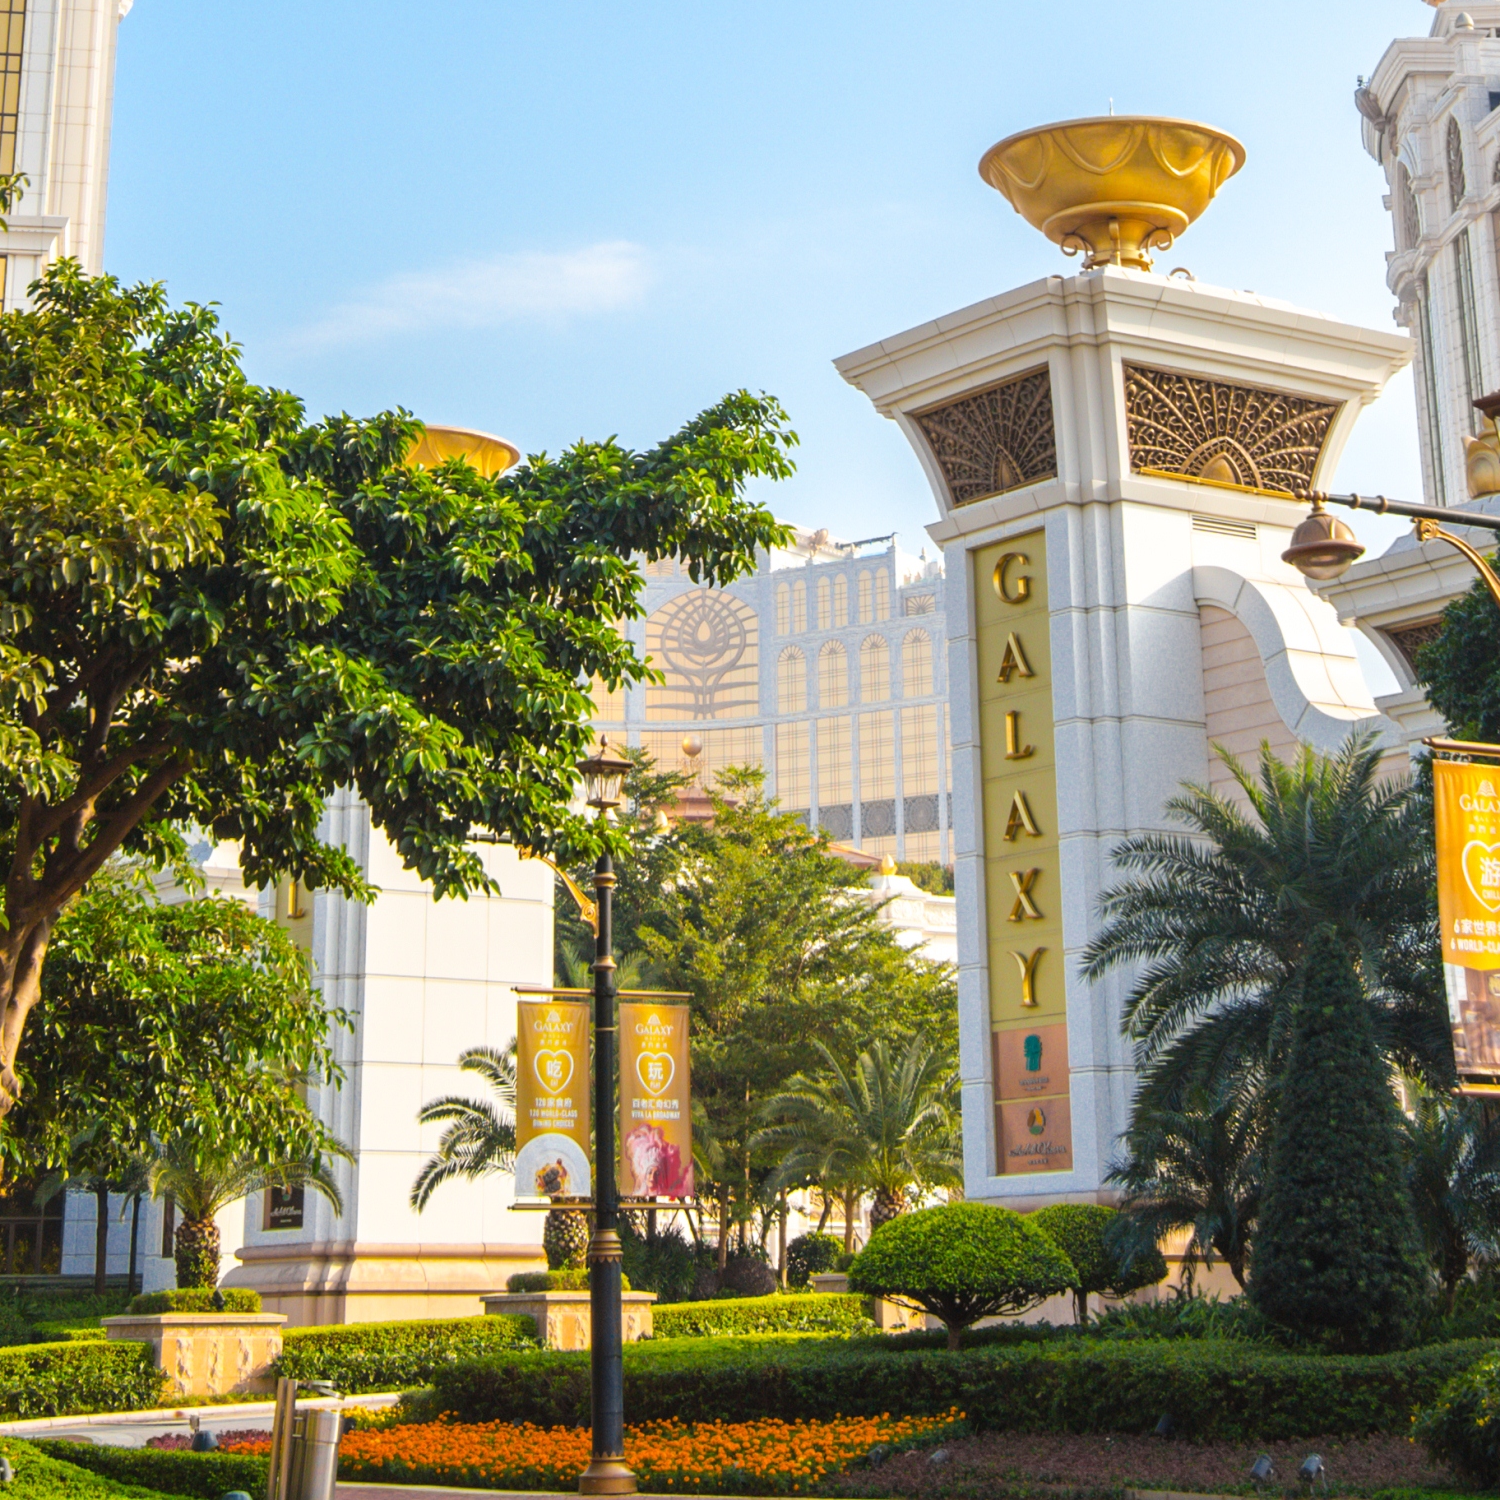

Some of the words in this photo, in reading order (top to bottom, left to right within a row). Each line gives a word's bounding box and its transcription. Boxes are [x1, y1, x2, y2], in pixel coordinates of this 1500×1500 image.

[993, 551, 1047, 1007] GALAXY
[1450, 937, 1456, 951] 6
[647, 1062, 664, 1081] 玩
